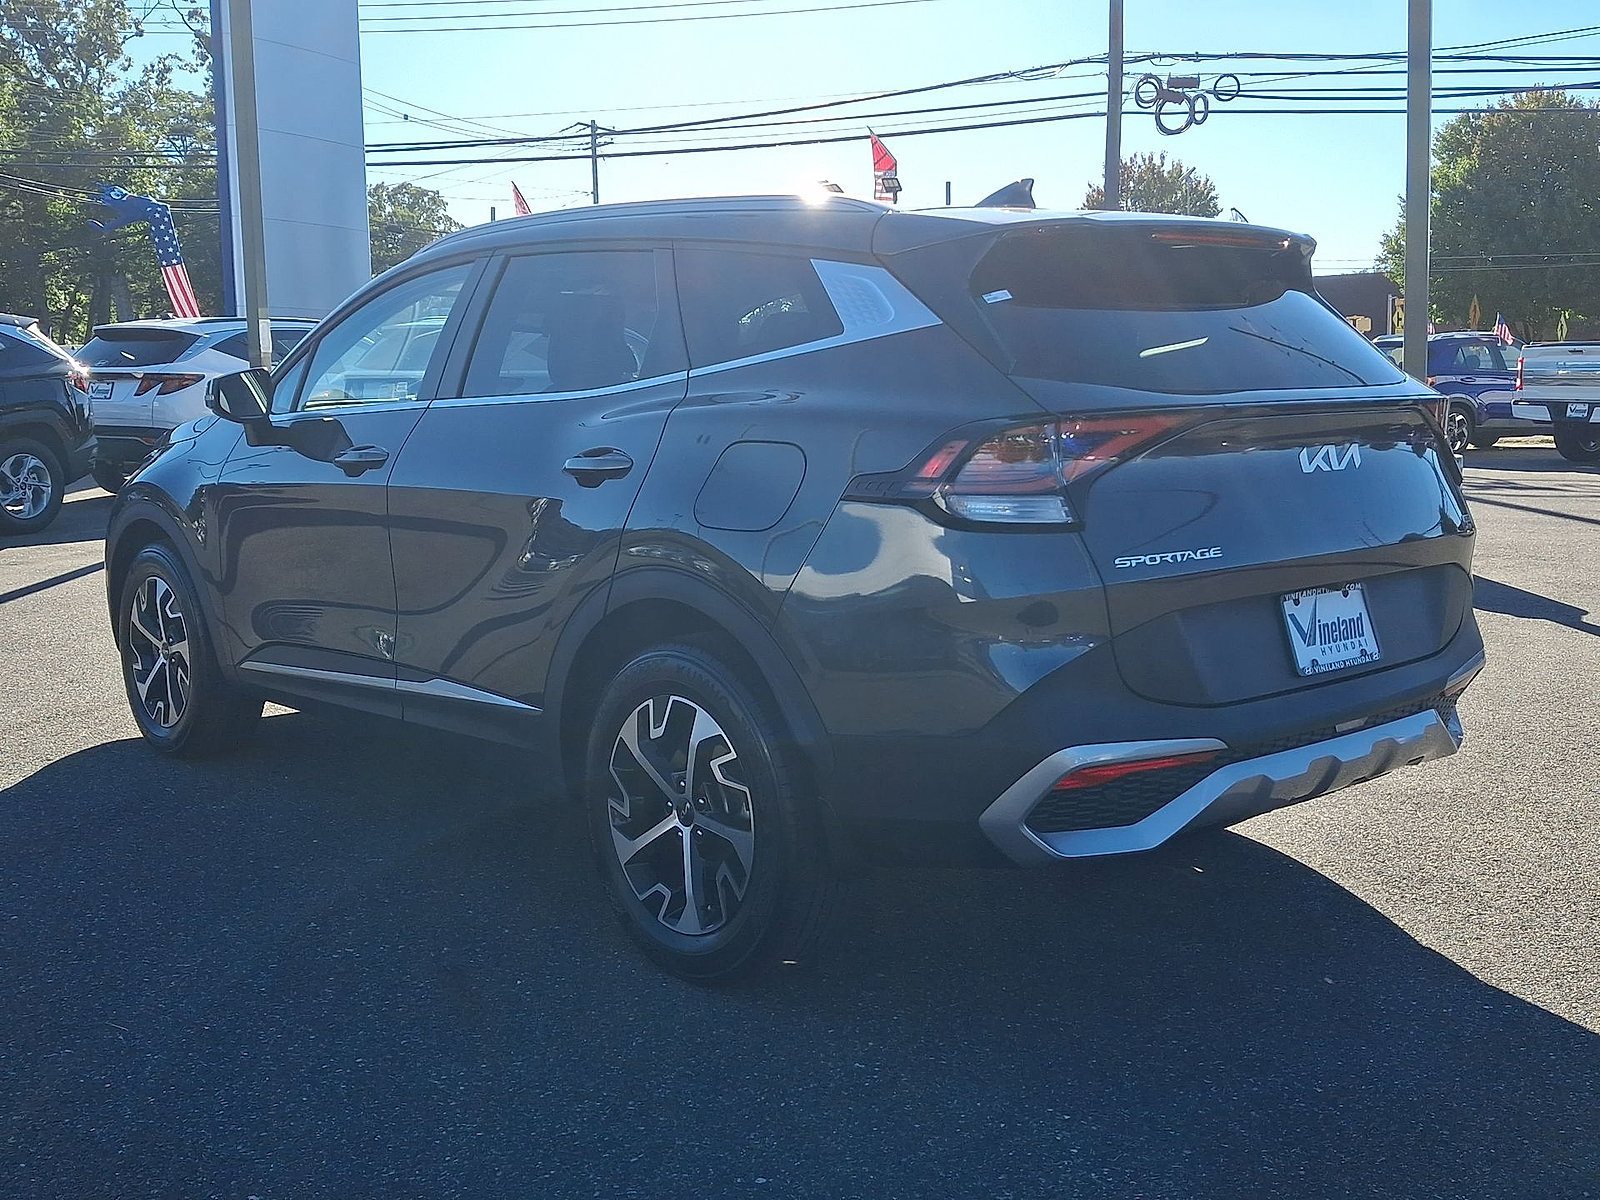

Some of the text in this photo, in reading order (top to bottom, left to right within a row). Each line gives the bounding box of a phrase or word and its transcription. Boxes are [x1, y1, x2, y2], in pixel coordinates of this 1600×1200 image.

[1299, 443, 1361, 473] KIA
[1114, 547, 1223, 568] SPORTAGE
[1288, 599, 1364, 647] Vineland
[1320, 638, 1368, 656] HYUNDAI
[1314, 662, 1345, 673] VINELAND
